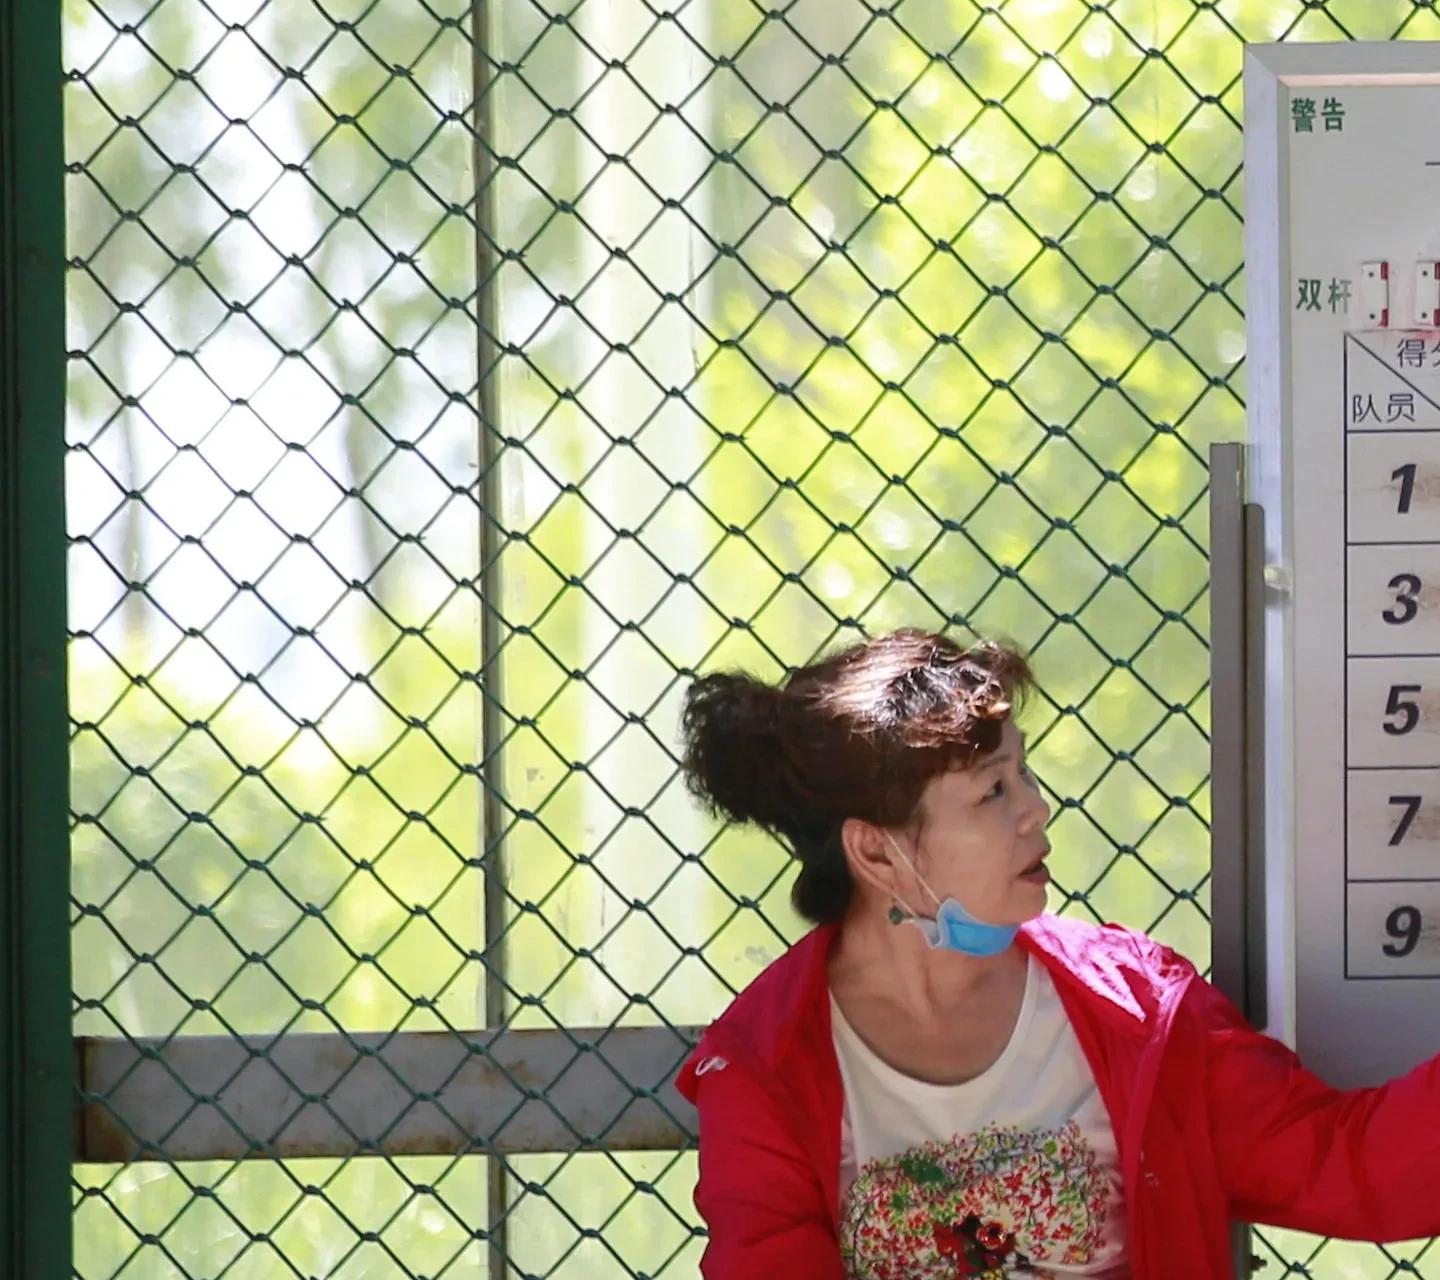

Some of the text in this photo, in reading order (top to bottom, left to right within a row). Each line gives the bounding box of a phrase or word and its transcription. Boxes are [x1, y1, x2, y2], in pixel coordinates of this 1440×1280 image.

[1291, 96, 1346, 132] 警告
[1296, 277, 1352, 314] 双杆
[1352, 393, 1417, 423] 队员
[1391, 463, 1418, 514] 1
[1382, 573, 1423, 625] 3
[1383, 684, 1423, 736] 5
[1388, 795, 1422, 847] 7
[1382, 905, 1423, 958] 9
